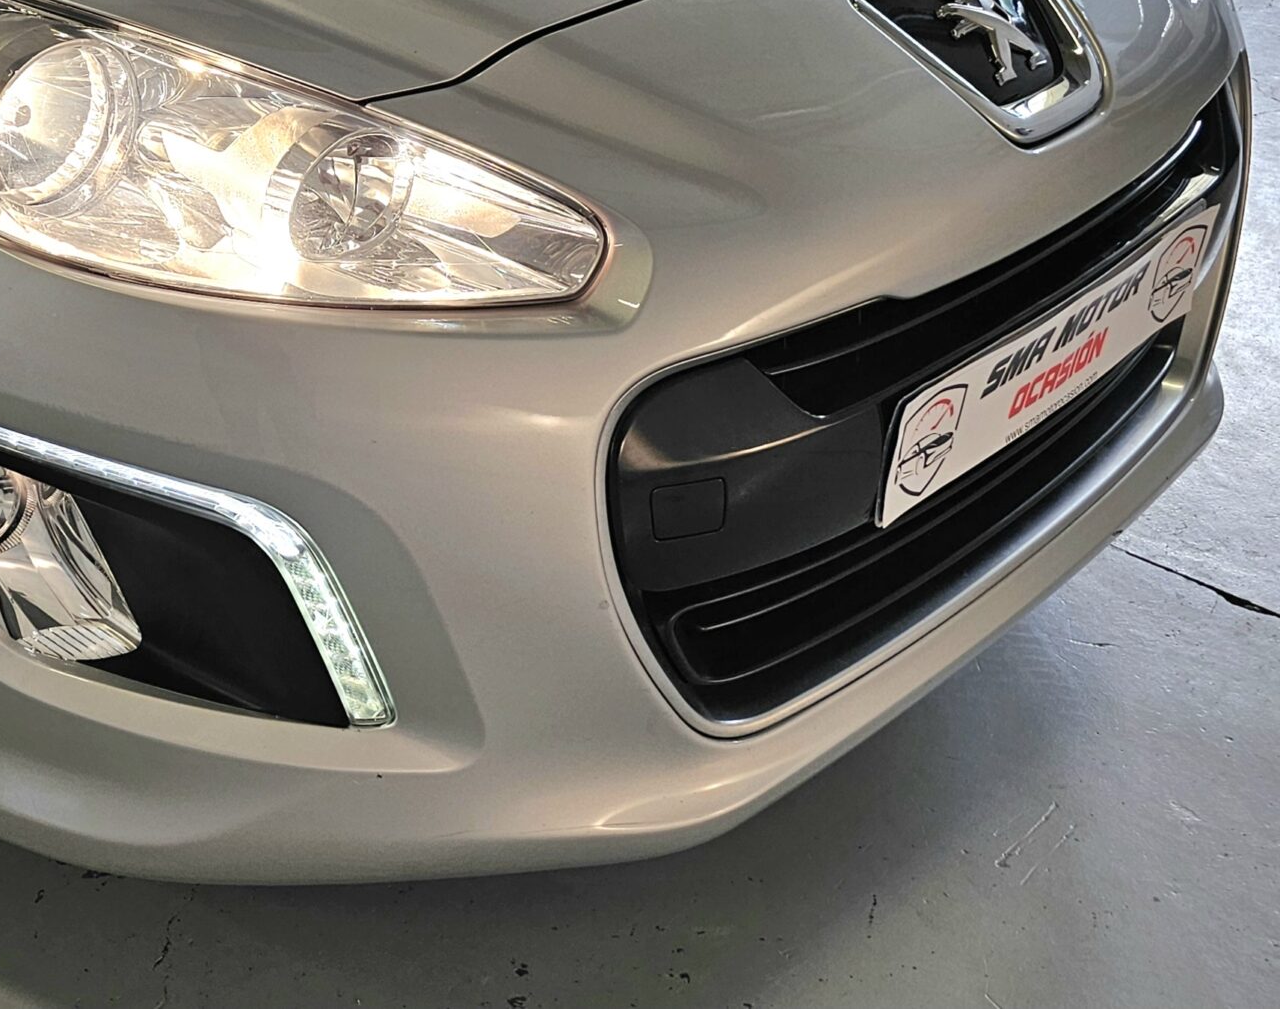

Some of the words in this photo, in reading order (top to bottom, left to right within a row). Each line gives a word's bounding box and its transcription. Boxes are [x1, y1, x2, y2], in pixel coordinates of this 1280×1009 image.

[980, 326, 1057, 399] SMA
[1052, 260, 1151, 352] MOTOR
[1008, 326, 1109, 419] OCASIÓN
